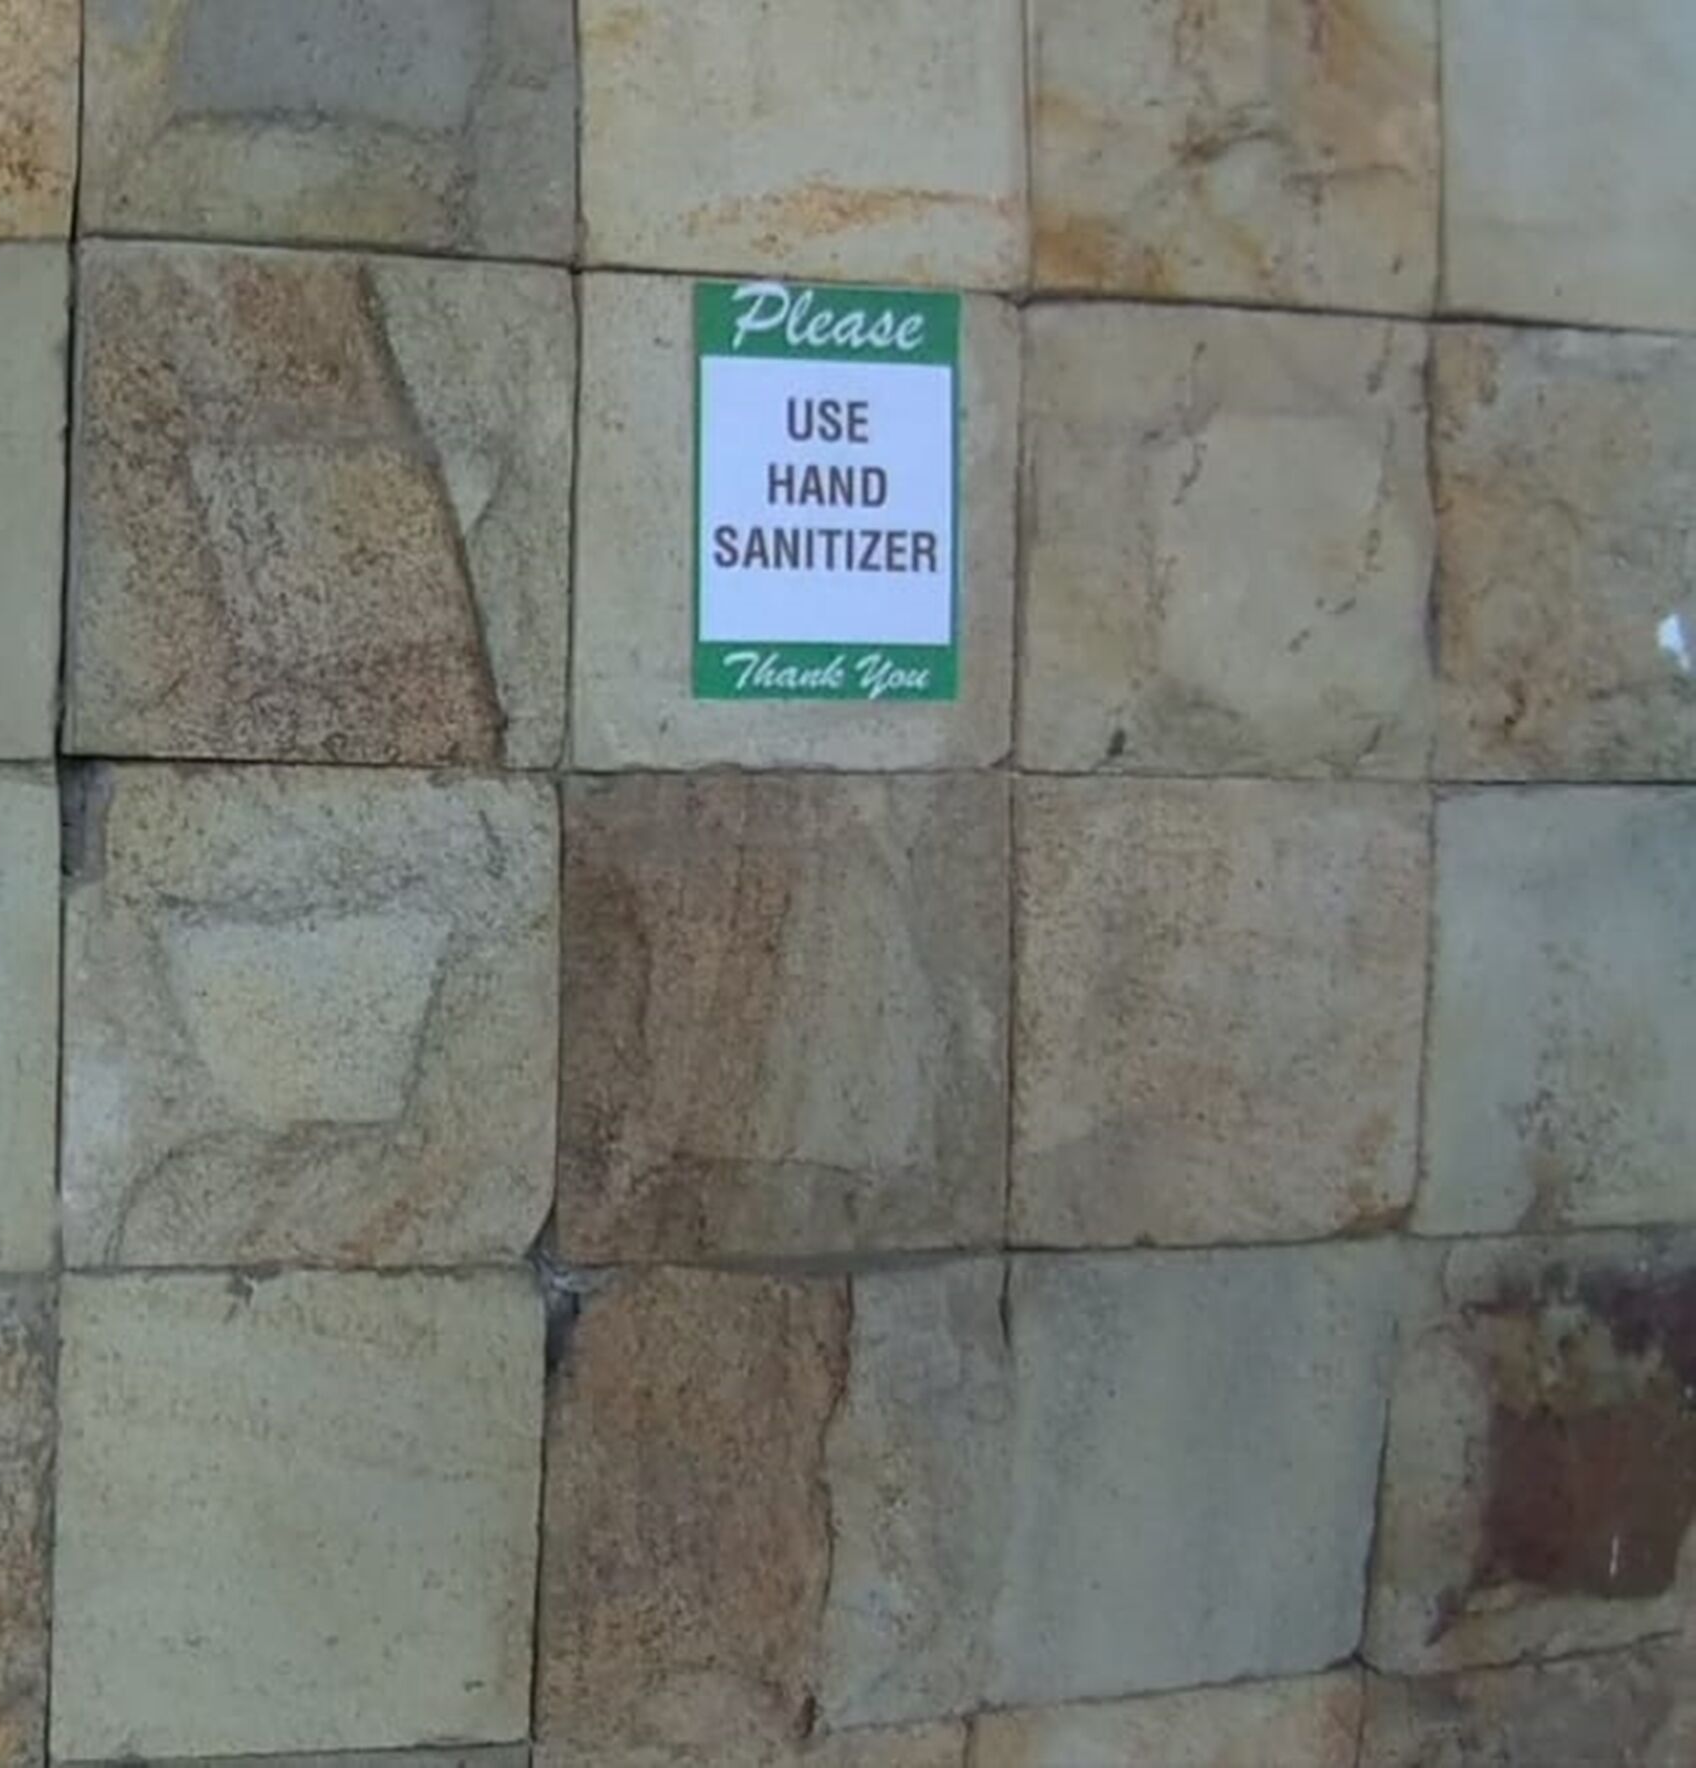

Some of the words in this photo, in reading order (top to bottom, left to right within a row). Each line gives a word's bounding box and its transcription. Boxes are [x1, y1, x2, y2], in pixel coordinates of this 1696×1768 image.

[731, 282, 924, 350] Please
[787, 397, 870, 443] USE
[767, 463, 888, 509] HAND
[713, 525, 938, 573] SANITIZER
[723, 650, 845, 690] Thank
[854, 654, 931, 699] You
